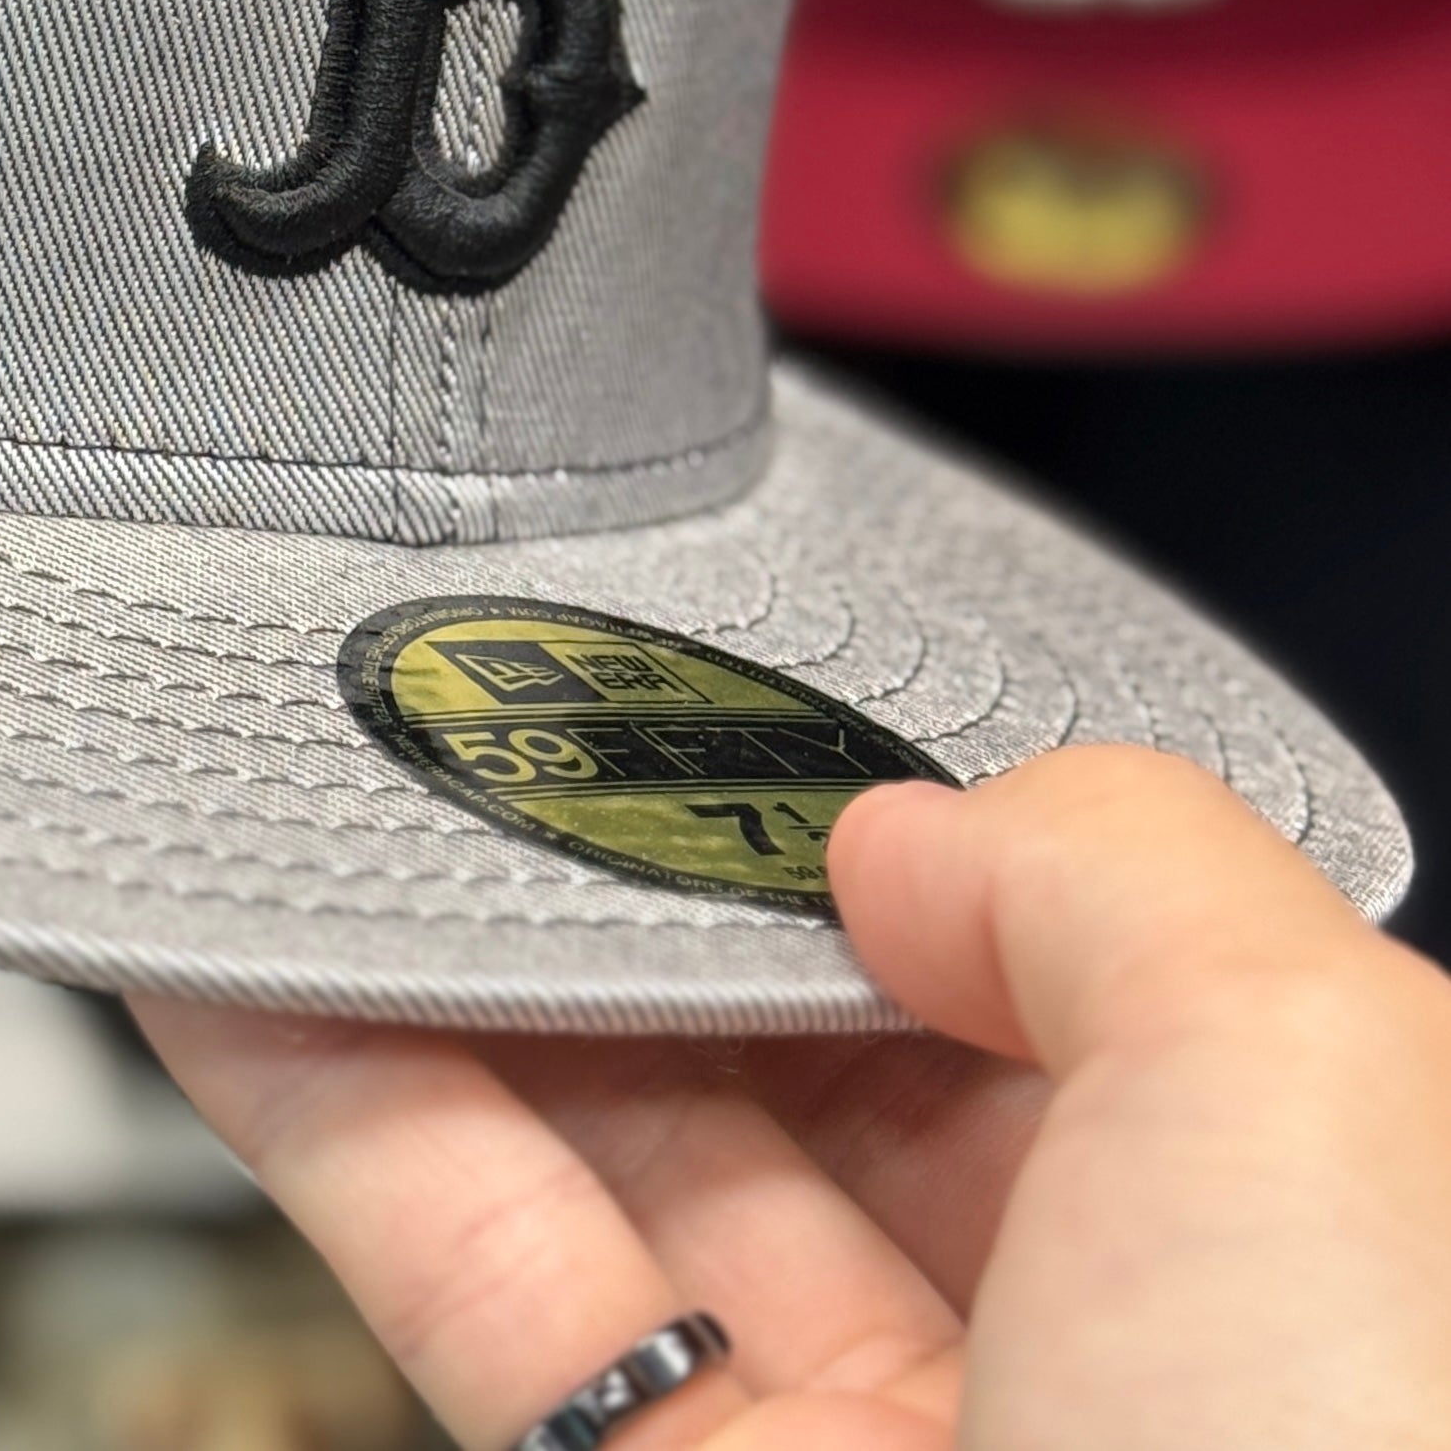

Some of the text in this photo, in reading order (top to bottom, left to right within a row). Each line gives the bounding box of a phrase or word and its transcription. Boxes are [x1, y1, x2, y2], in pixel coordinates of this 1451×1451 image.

[565, 653, 654, 672] NEW
[589, 671, 684, 693] ERA
[686, 803, 786, 856] 7
